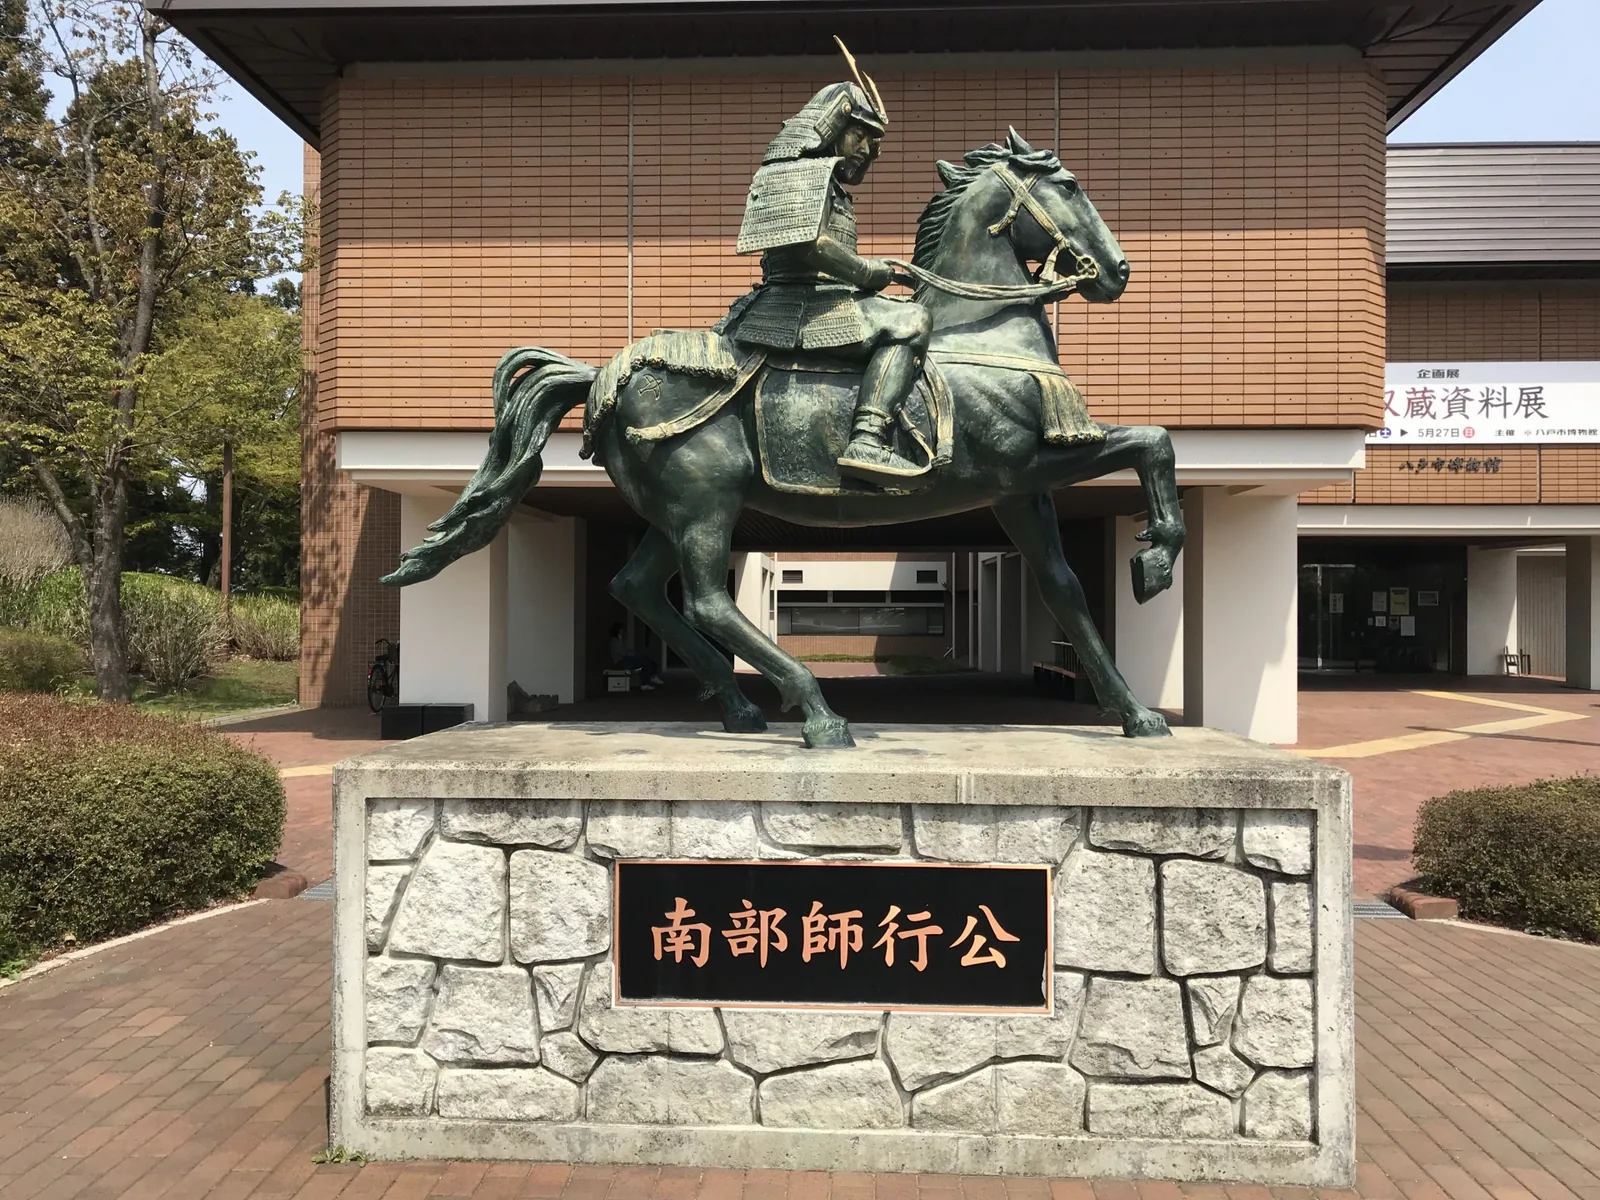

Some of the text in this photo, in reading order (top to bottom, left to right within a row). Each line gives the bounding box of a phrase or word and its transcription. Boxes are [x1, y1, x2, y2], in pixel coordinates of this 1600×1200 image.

[1417, 368, 1460, 379] 企画展
[651, 896, 1020, 972] 南部師行公
